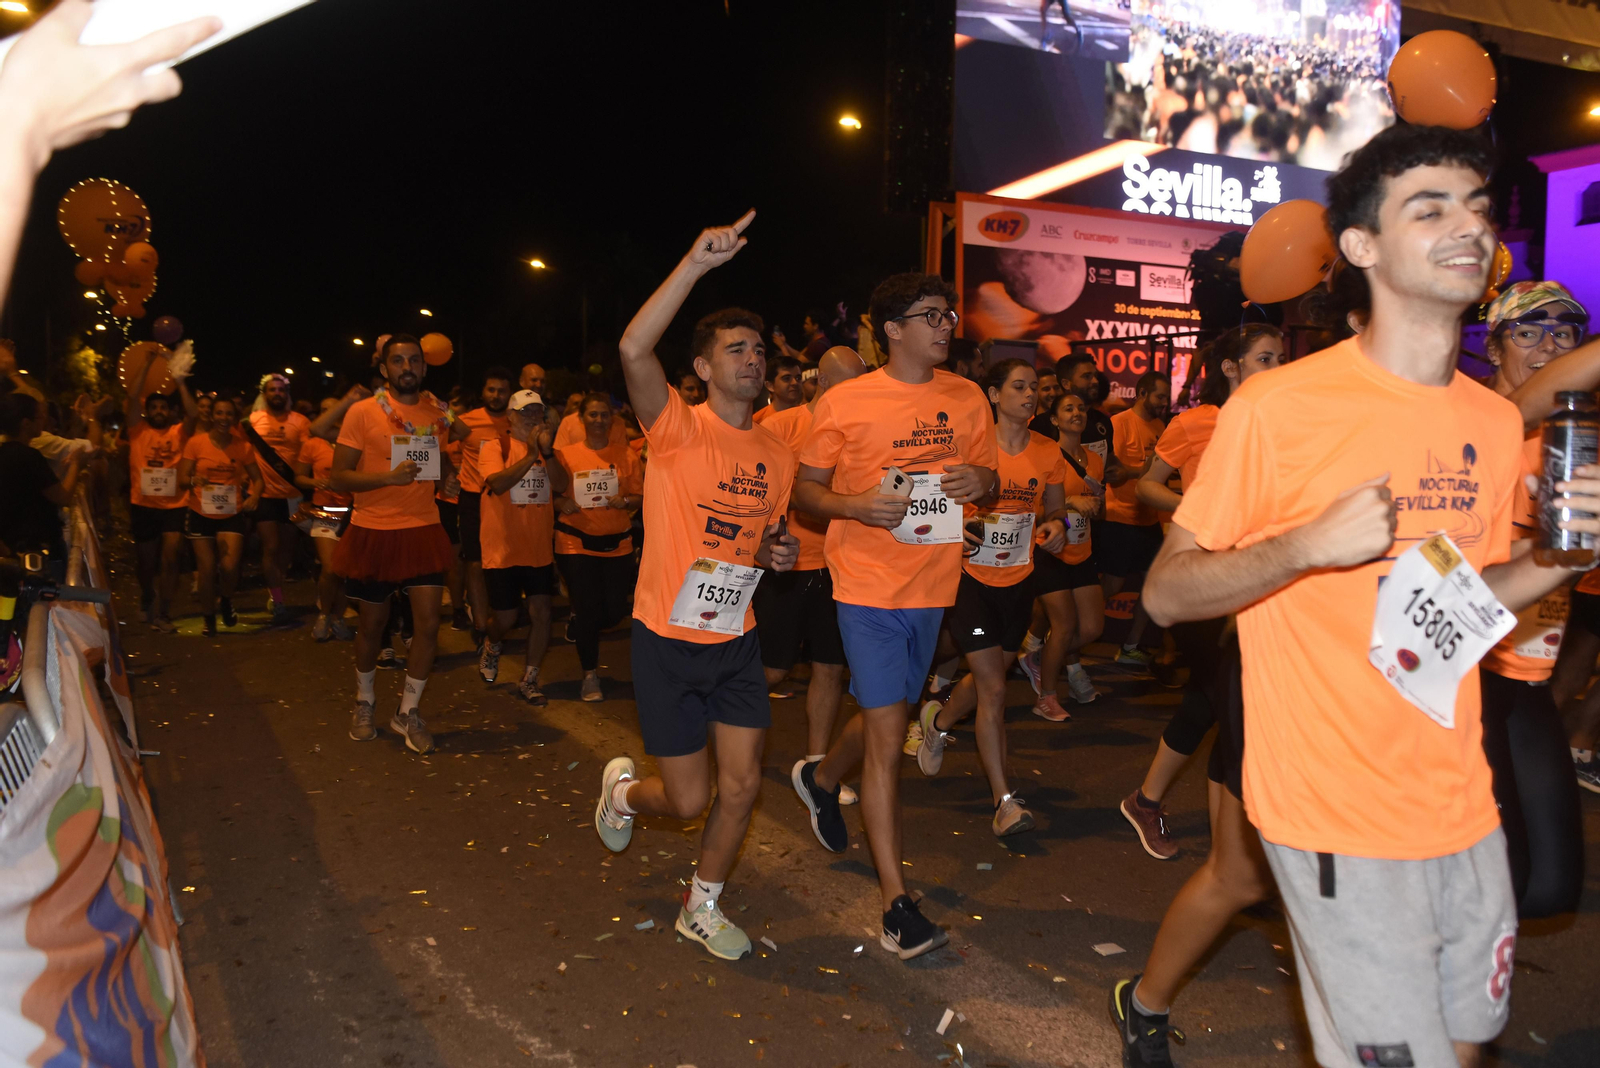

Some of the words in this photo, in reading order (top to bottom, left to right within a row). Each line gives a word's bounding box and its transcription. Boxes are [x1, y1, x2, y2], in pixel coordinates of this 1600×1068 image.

[1122, 153, 1253, 213] Sevilla.
[1041, 224, 1063, 236] ABC
[1073, 229, 1120, 244] Cruzcampo
[1114, 303, 1126, 313] 30
[1127, 304, 1139, 315] de
[1140, 305, 1191, 319] septiembre
[1085, 319, 1150, 345] XXXIV
[911, 428, 954, 437] NOCTURNA
[892, 439, 931, 449] SEVILLA
[406, 450, 430, 462] 5588
[520, 478, 545, 489] 21735
[586, 481, 608, 492] 9743
[717, 481, 747, 496] SEVILLA
[731, 476, 769, 490] NOCTURNA
[1419, 477, 1479, 494] NOCTURNA
[1002, 488, 1037, 497] NOCTURNA
[904, 497, 948, 517] 5946
[1395, 495, 1447, 511] EVILLA
[991, 531, 1020, 546] 8541
[697, 582, 742, 606] 15373
[1404, 587, 1465, 662] 15805
